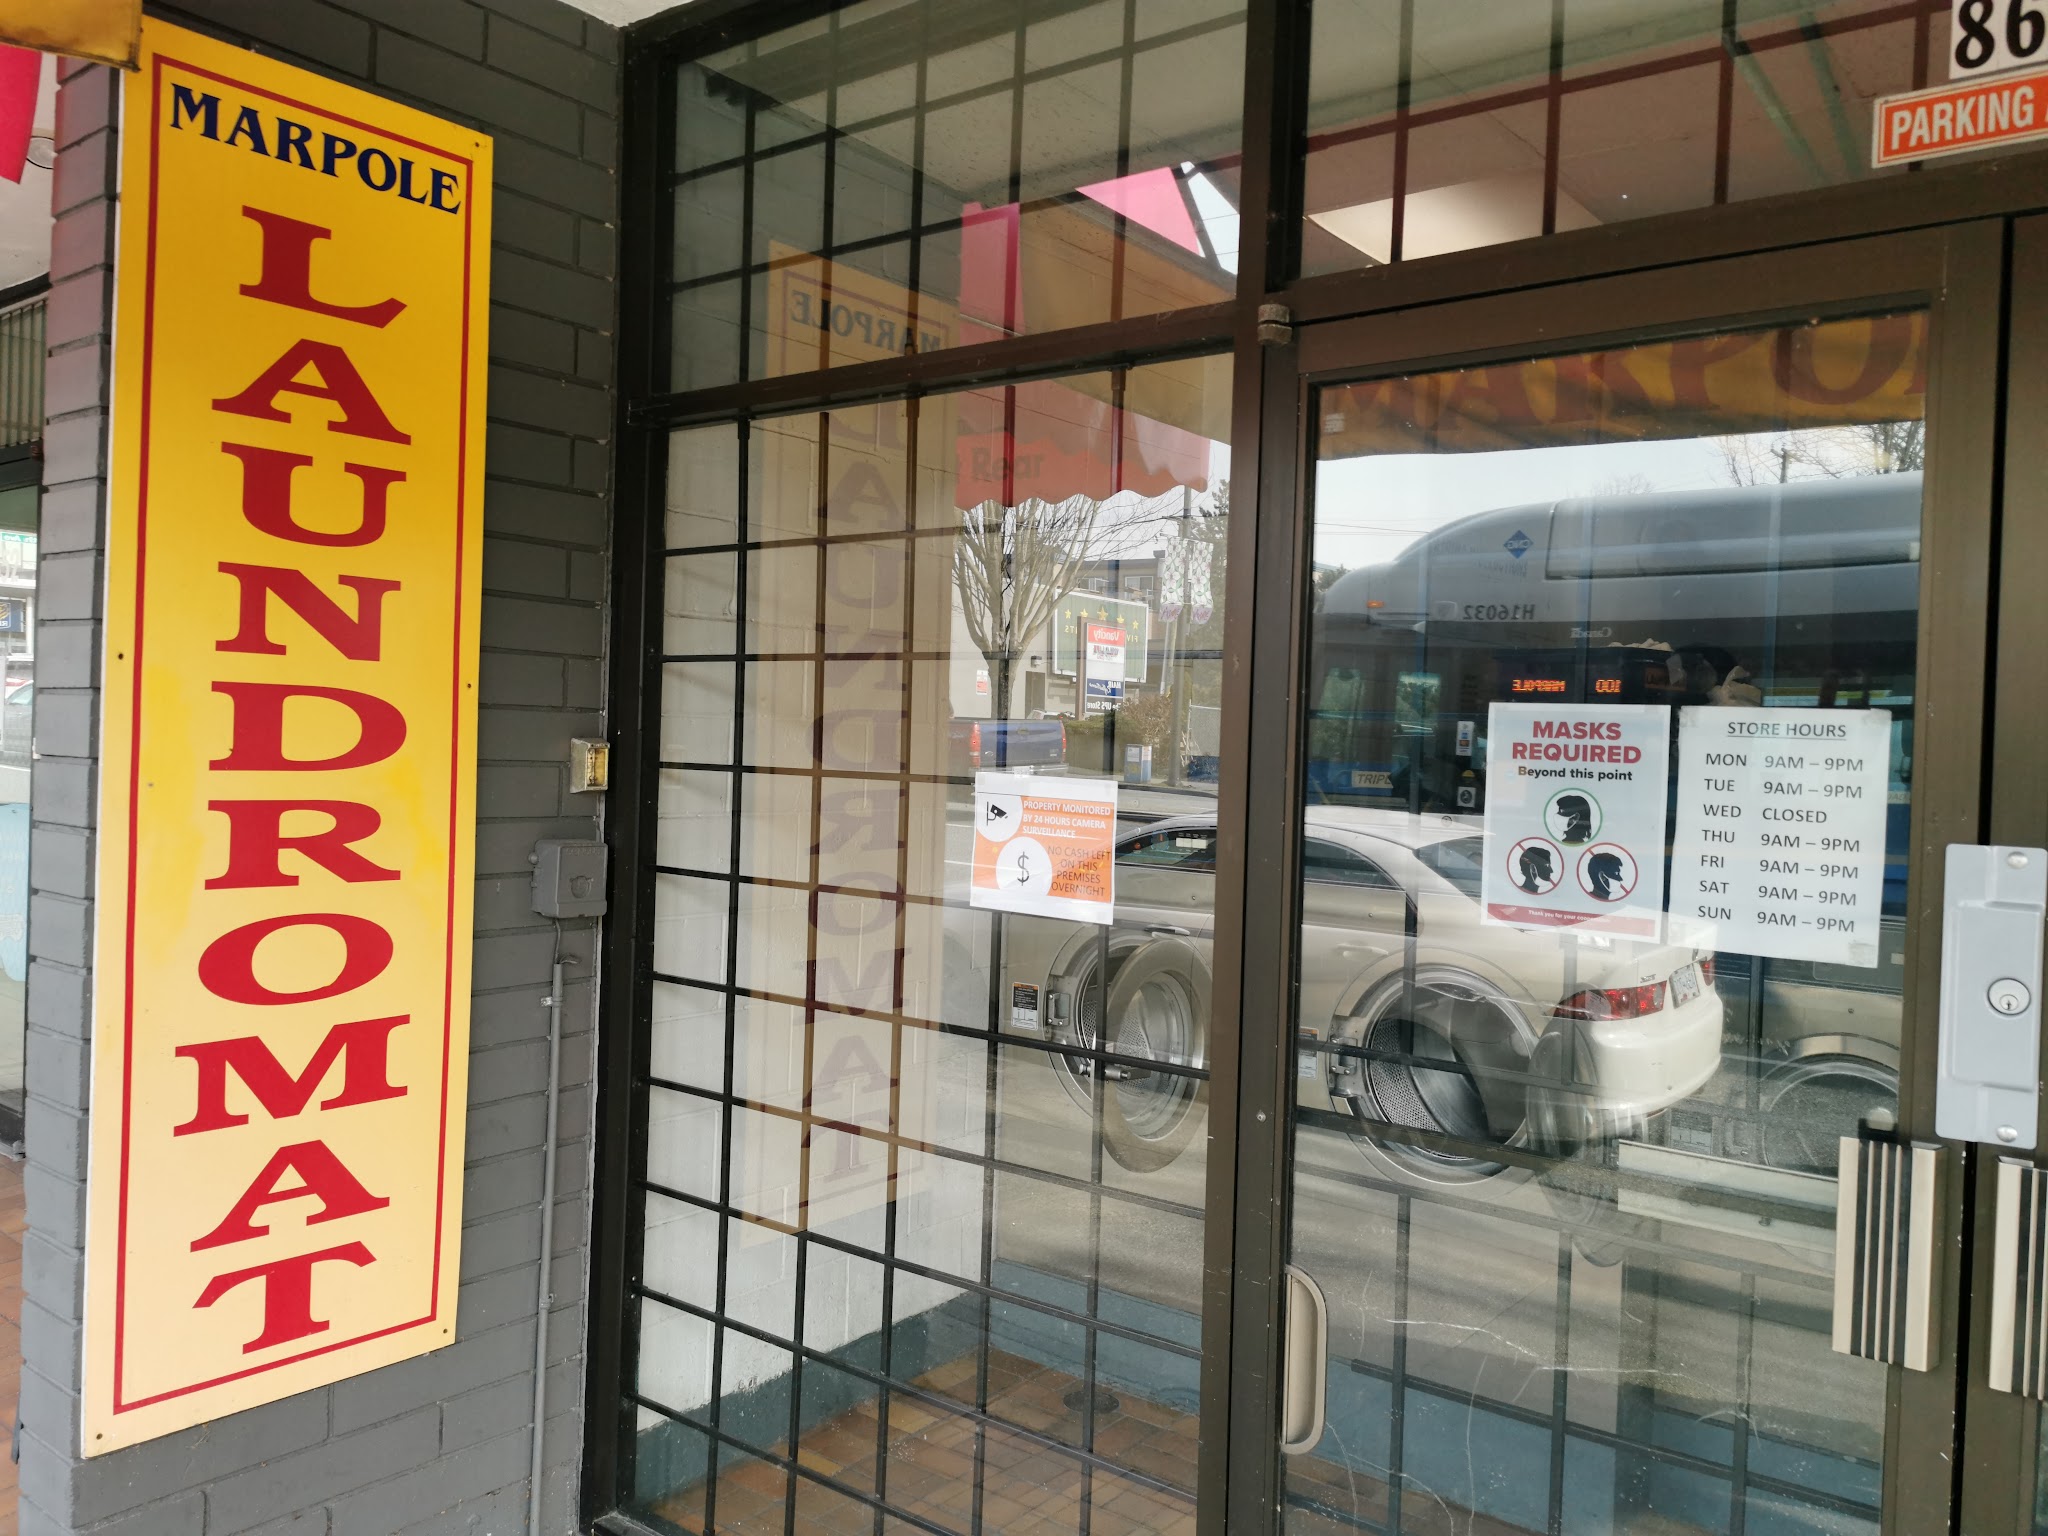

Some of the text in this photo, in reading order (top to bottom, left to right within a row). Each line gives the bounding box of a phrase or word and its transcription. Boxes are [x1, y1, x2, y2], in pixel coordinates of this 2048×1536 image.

[1891, 85, 2035, 150] PARKING
[171, 83, 461, 214] MARPOLE
[1532, 720, 1622, 741] MASKS
[1727, 722, 1847, 738] STORE HOURS
[1512, 742, 1641, 764] REQUIRED
[1705, 753, 1748, 767] MON
[1764, 755, 1804, 770] 9AM
[1824, 757, 1863, 772] 9PM
[173, 205, 411, 1354] LAUNDROMAT
[1358, 774, 1391, 785] TRIPL
[1518, 766, 1633, 781] Beyond this point
[1704, 778, 1736, 792] TUE
[1763, 781, 1803, 796] 9AM
[1823, 784, 1862, 799] 9PM
[1024, 800, 1111, 816] PROPERTY MONITORED
[1703, 803, 1827, 824] WED CLOSED
[1023, 814, 1106, 829] BY 24 HOURS CAMERA
[1022, 826, 1076, 838] SURVEILLANCE
[1701, 829, 1736, 843] THU
[1760, 833, 1800, 848] 9AM
[1820, 837, 1860, 853] 9PM
[1047, 845, 1111, 861] NO CASH LEFT
[1060, 859, 1098, 871] ON THIS
[1700, 854, 1725, 869] FRI
[1759, 859, 1799, 874] 9AM
[1819, 863, 1859, 879] 9PM
[1056, 870, 1101, 884] PREMISES
[1051, 882, 1105, 896] OVERNIGHT
[1699, 880, 1730, 894] SAT
[1758, 885, 1798, 901] 9AM
[1818, 890, 1857, 906] 9PM
[1528, 909, 1544, 917] Thank
[1544, 911, 1554, 919] you
[1697, 905, 1731, 920] SUN
[1756, 911, 1797, 927] 9AM
[1816, 917, 1855, 933] 9PM
